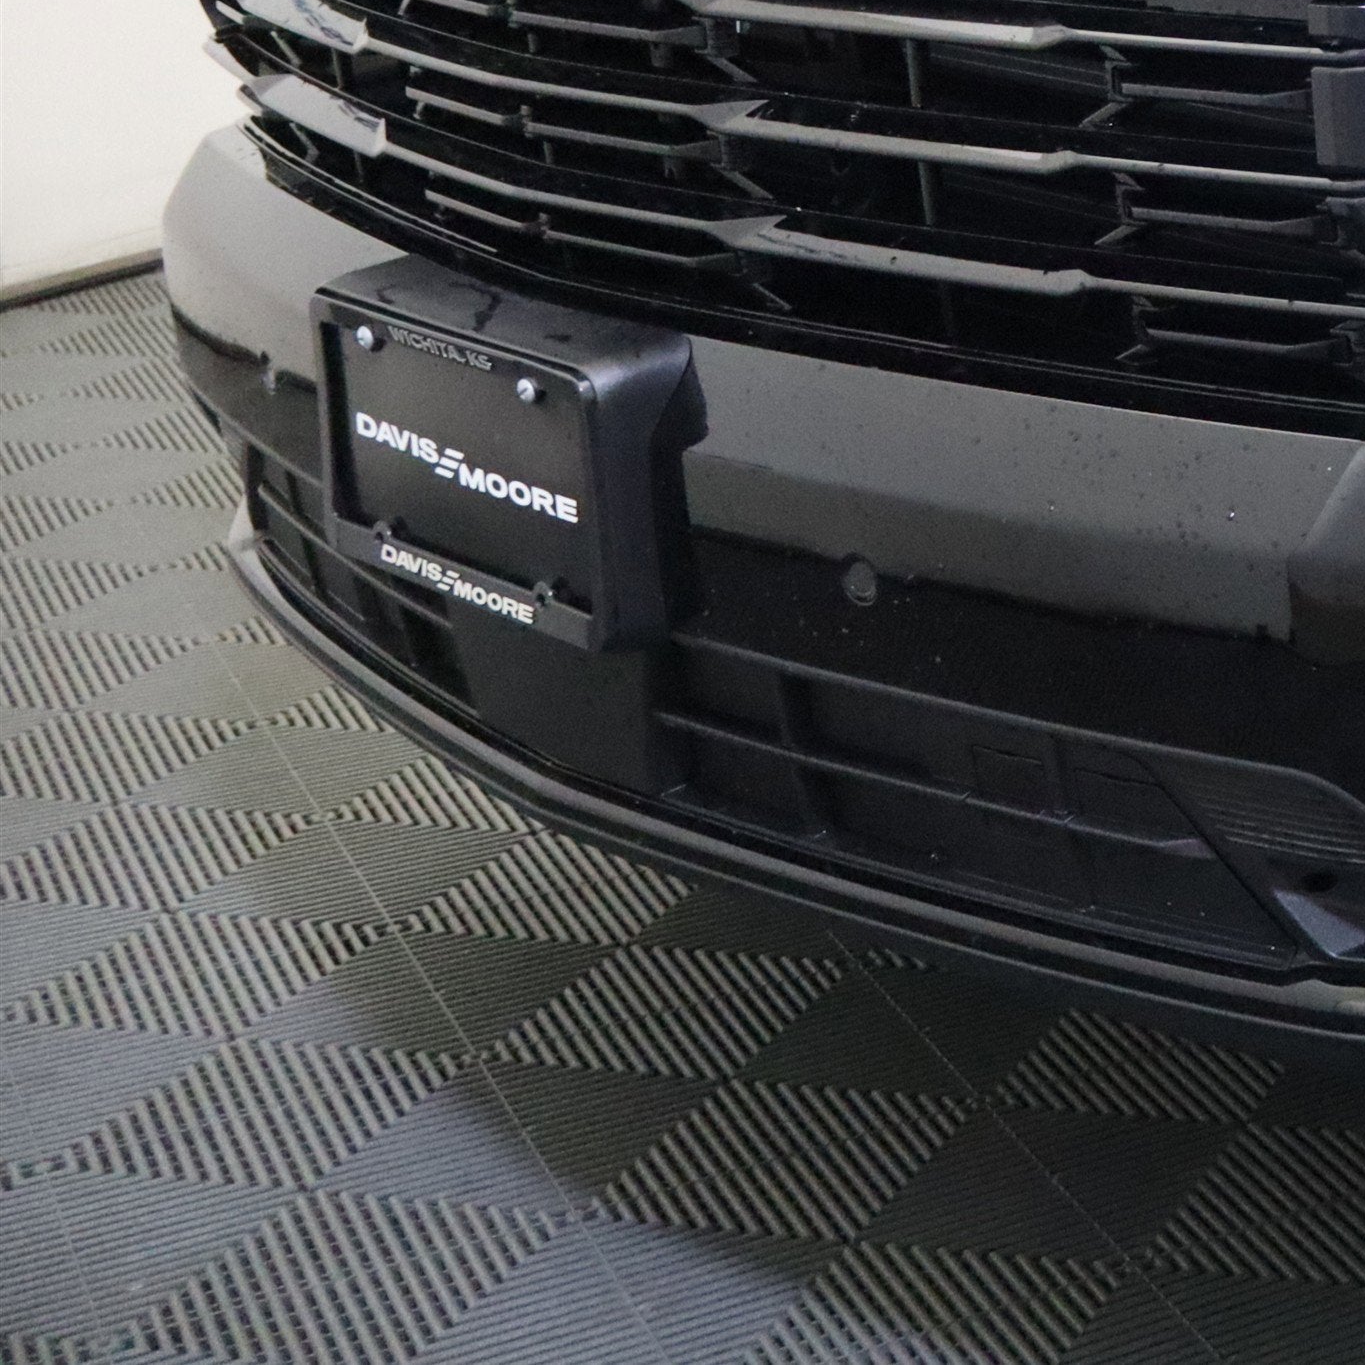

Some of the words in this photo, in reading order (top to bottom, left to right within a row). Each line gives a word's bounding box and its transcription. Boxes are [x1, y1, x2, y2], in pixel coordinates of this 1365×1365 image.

[465, 349, 494, 372] KS
[355, 411, 439, 464] DAVIS
[458, 463, 579, 524] MOORE
[381, 542, 442, 582] DAVIS
[452, 578, 536, 625] MOORE
